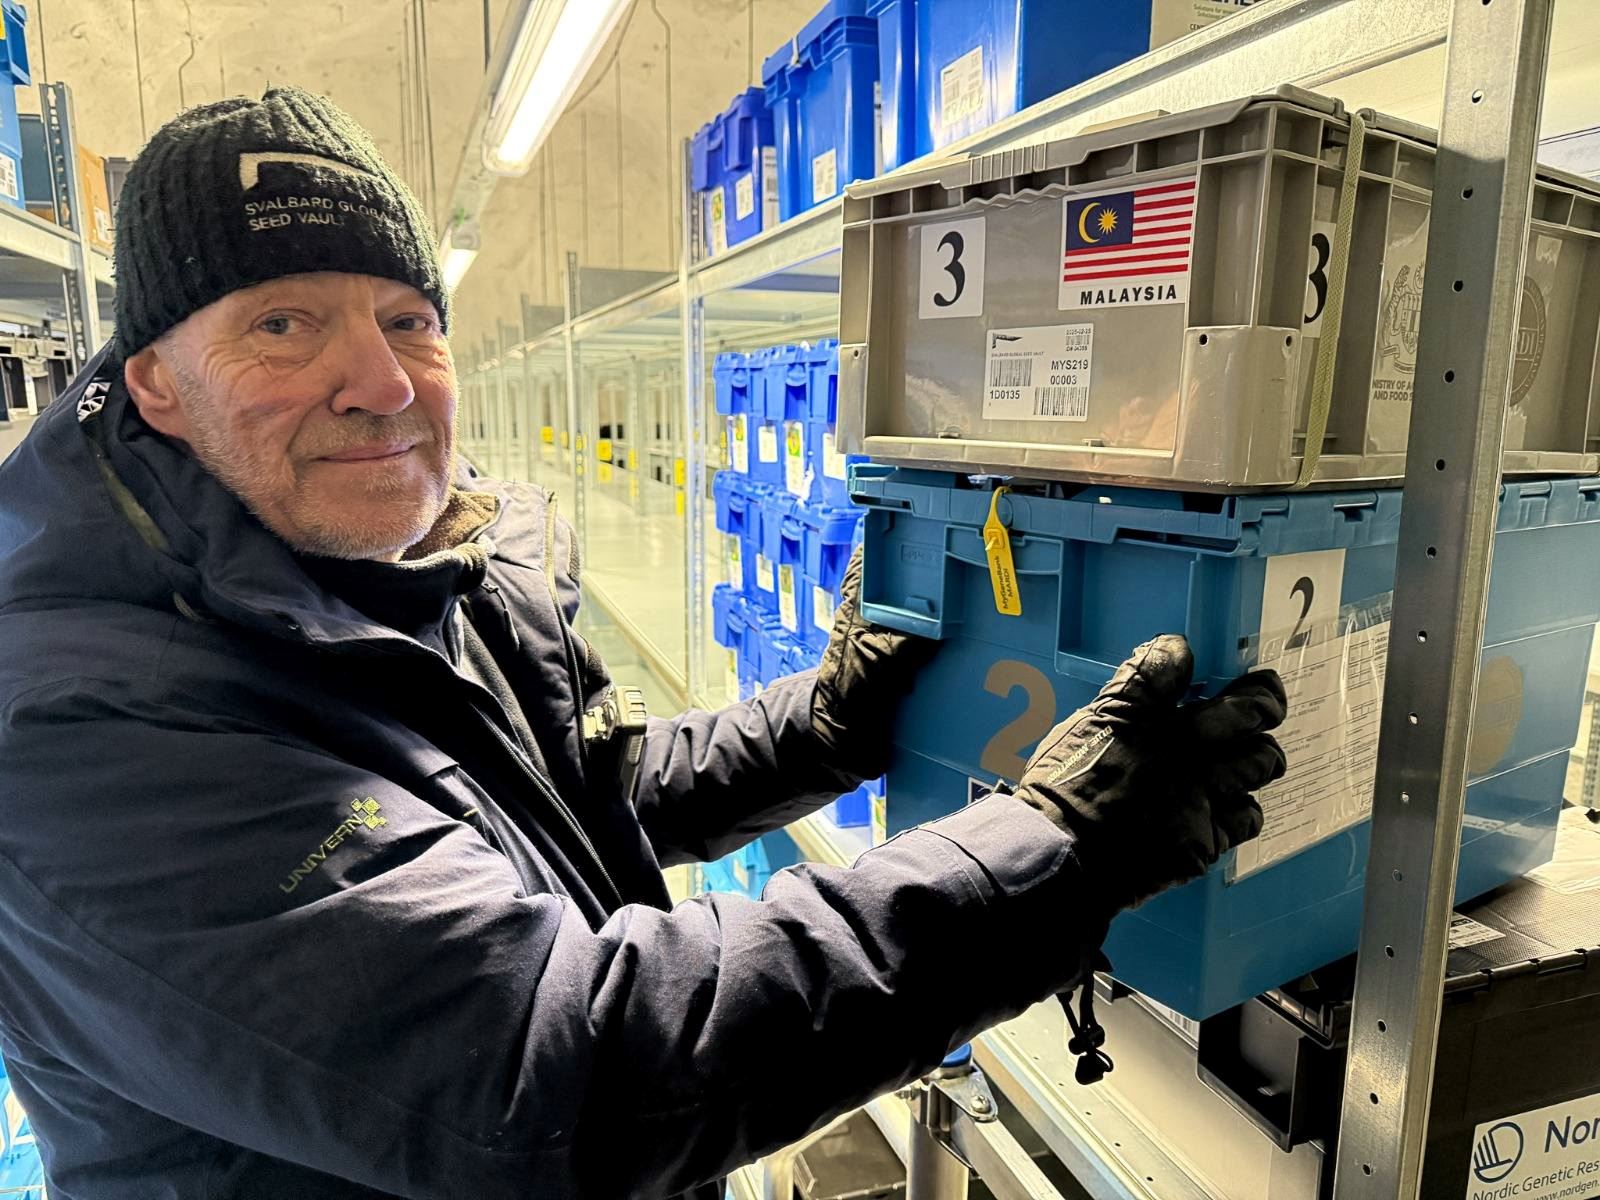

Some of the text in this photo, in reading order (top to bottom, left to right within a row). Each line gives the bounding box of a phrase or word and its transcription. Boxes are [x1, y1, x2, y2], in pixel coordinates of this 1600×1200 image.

[245, 196, 390, 223] SVALBARD GLOBA
[249, 213, 291, 231] SEED
[933, 231, 966, 307] 3
[1303, 232, 1330, 325] 3
[1080, 284, 1177, 305] MALAYSIA
[1050, 360, 1089, 370] MYS219
[1050, 375, 1078, 385] 00003
[1372, 379, 1396, 389] NISTRY
[1396, 380, 1406, 390] OF
[1373, 390, 1388, 400] AND
[1390, 391, 1408, 401] FOOD
[1003, 568, 1014, 598] MARDI
[1284, 576, 1314, 650] 2
[980, 659, 1056, 786] 2
[279, 813, 364, 893] UNIVERN
[1473, 1182, 1520, 1200] Nordic
[1522, 1166, 1574, 1192] Genetic
